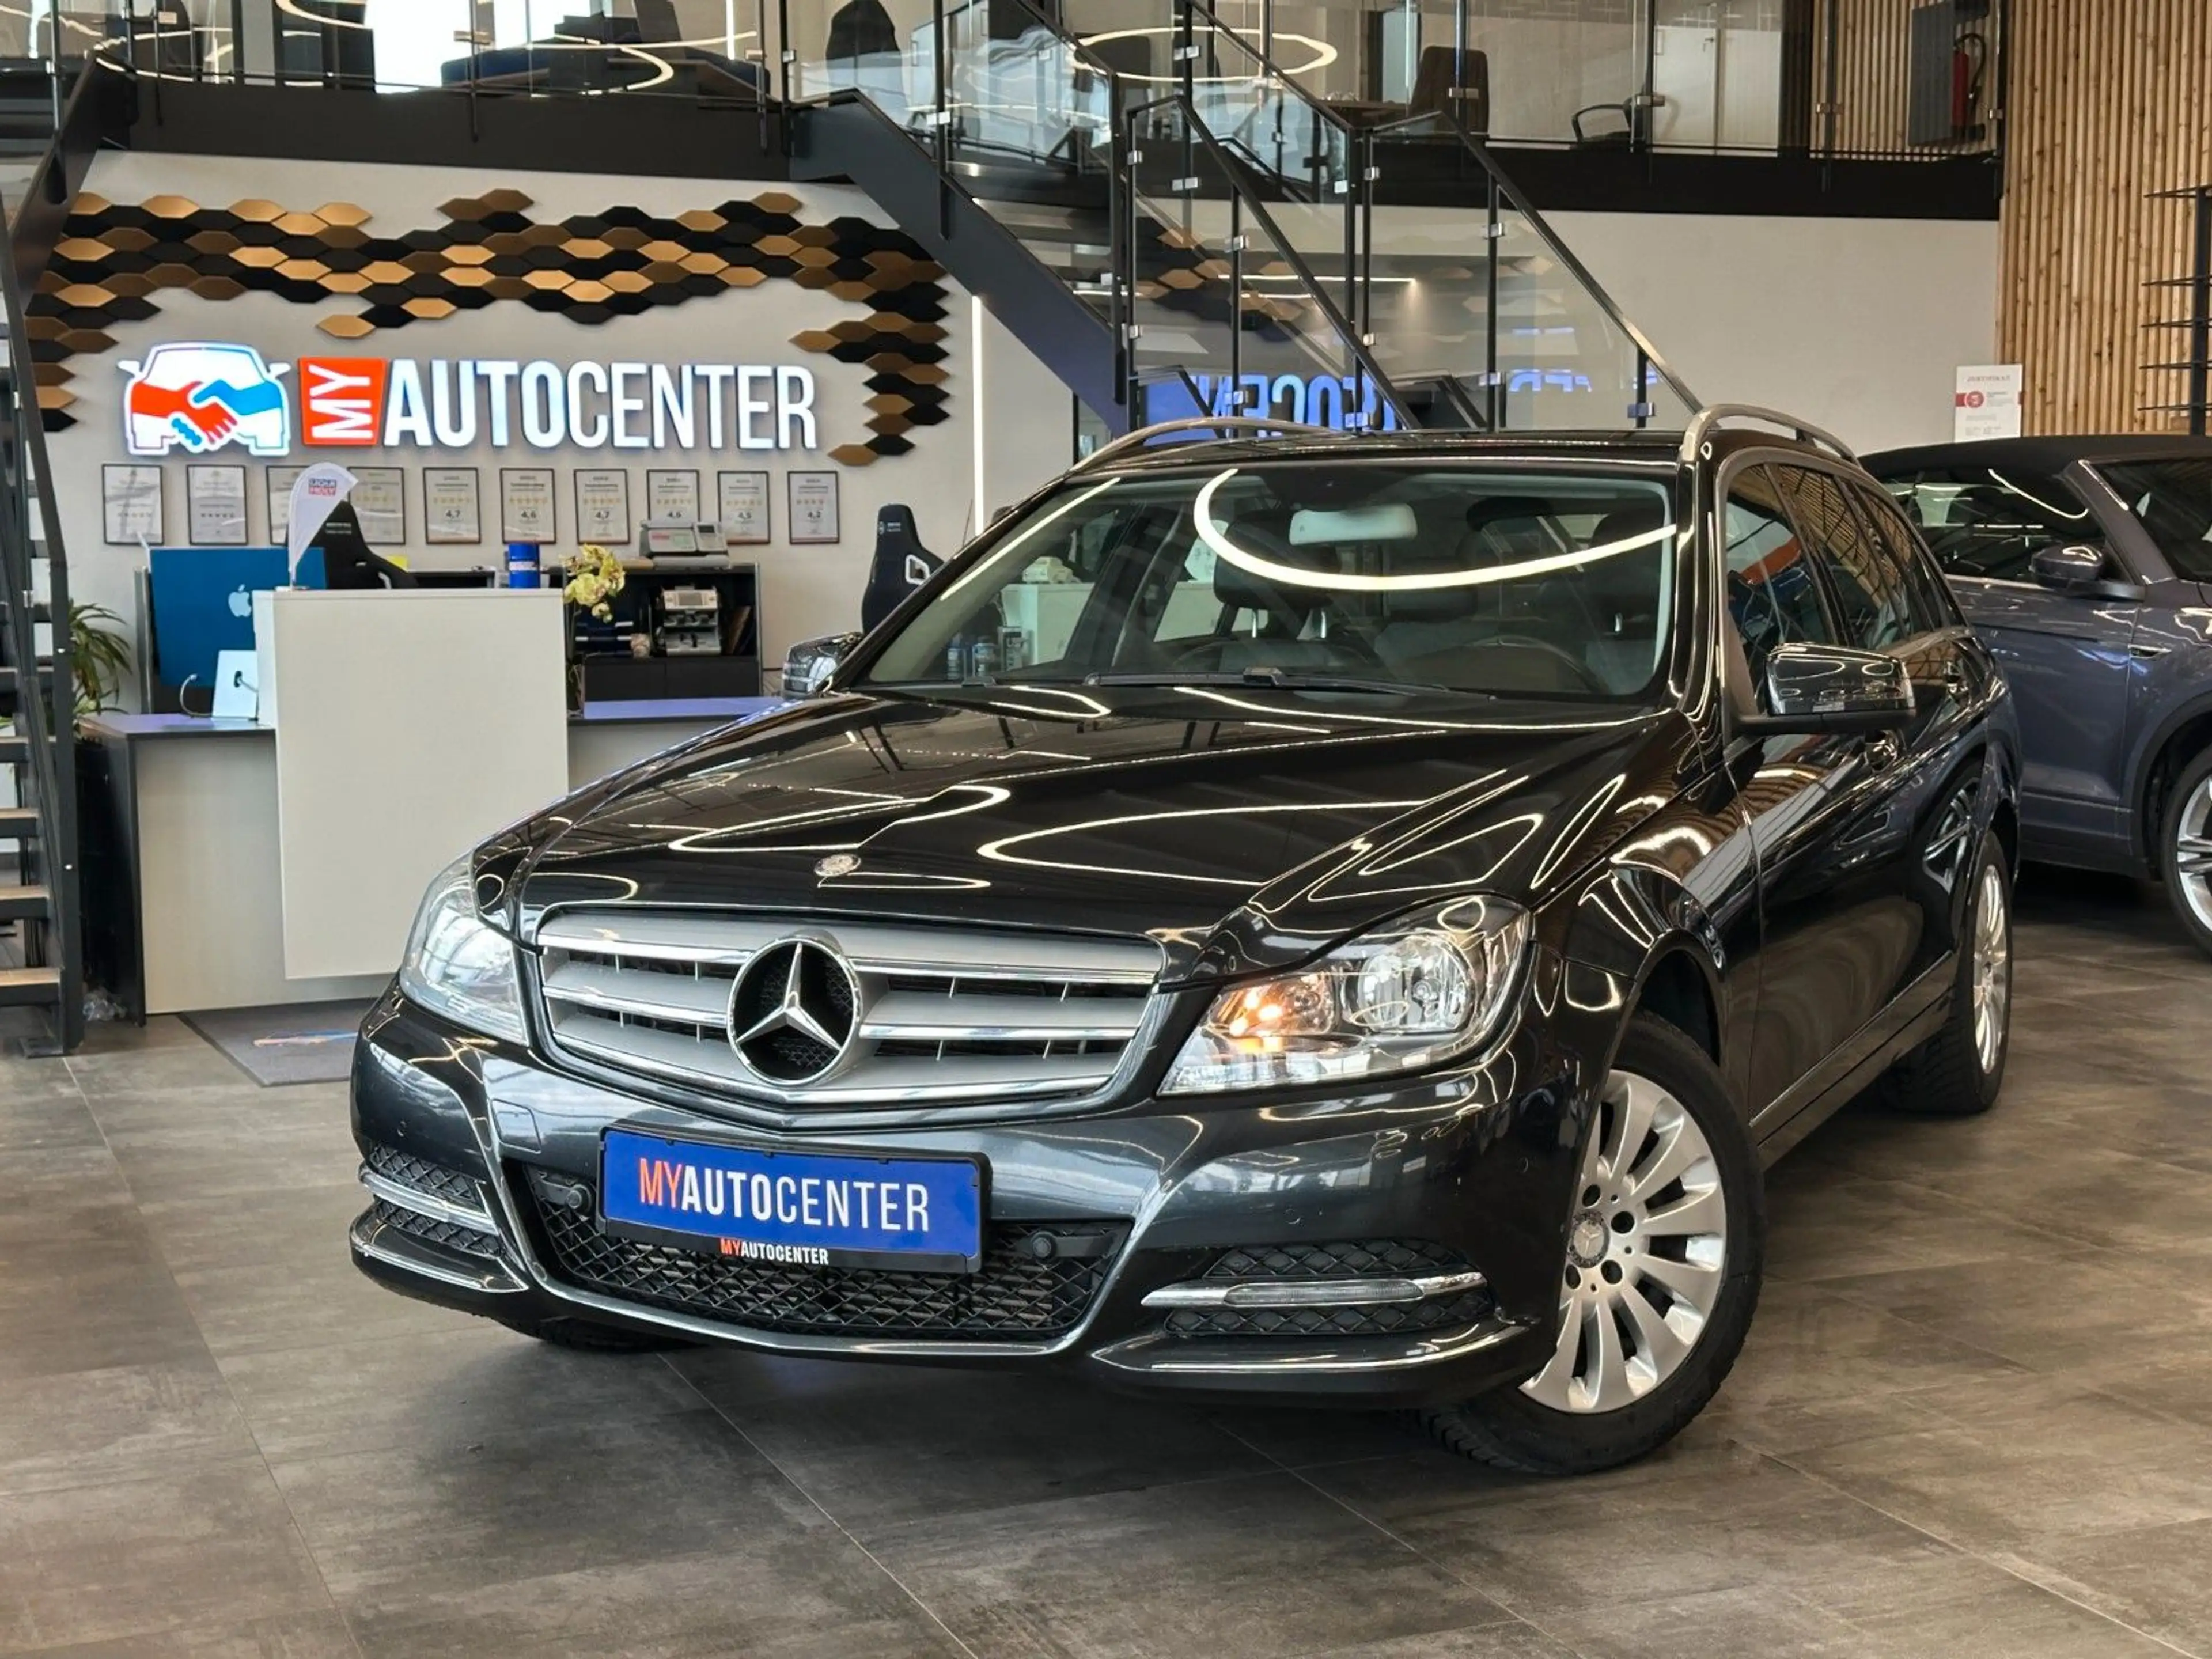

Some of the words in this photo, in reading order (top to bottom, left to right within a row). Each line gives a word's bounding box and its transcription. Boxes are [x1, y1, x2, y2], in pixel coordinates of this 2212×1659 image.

[308, 365, 373, 439] MY
[384, 359, 817, 449] AUTOCENTER
[640, 1158, 929, 1232] MYAUTOCENTER
[719, 1238, 829, 1266] MYAUTOCENTER
